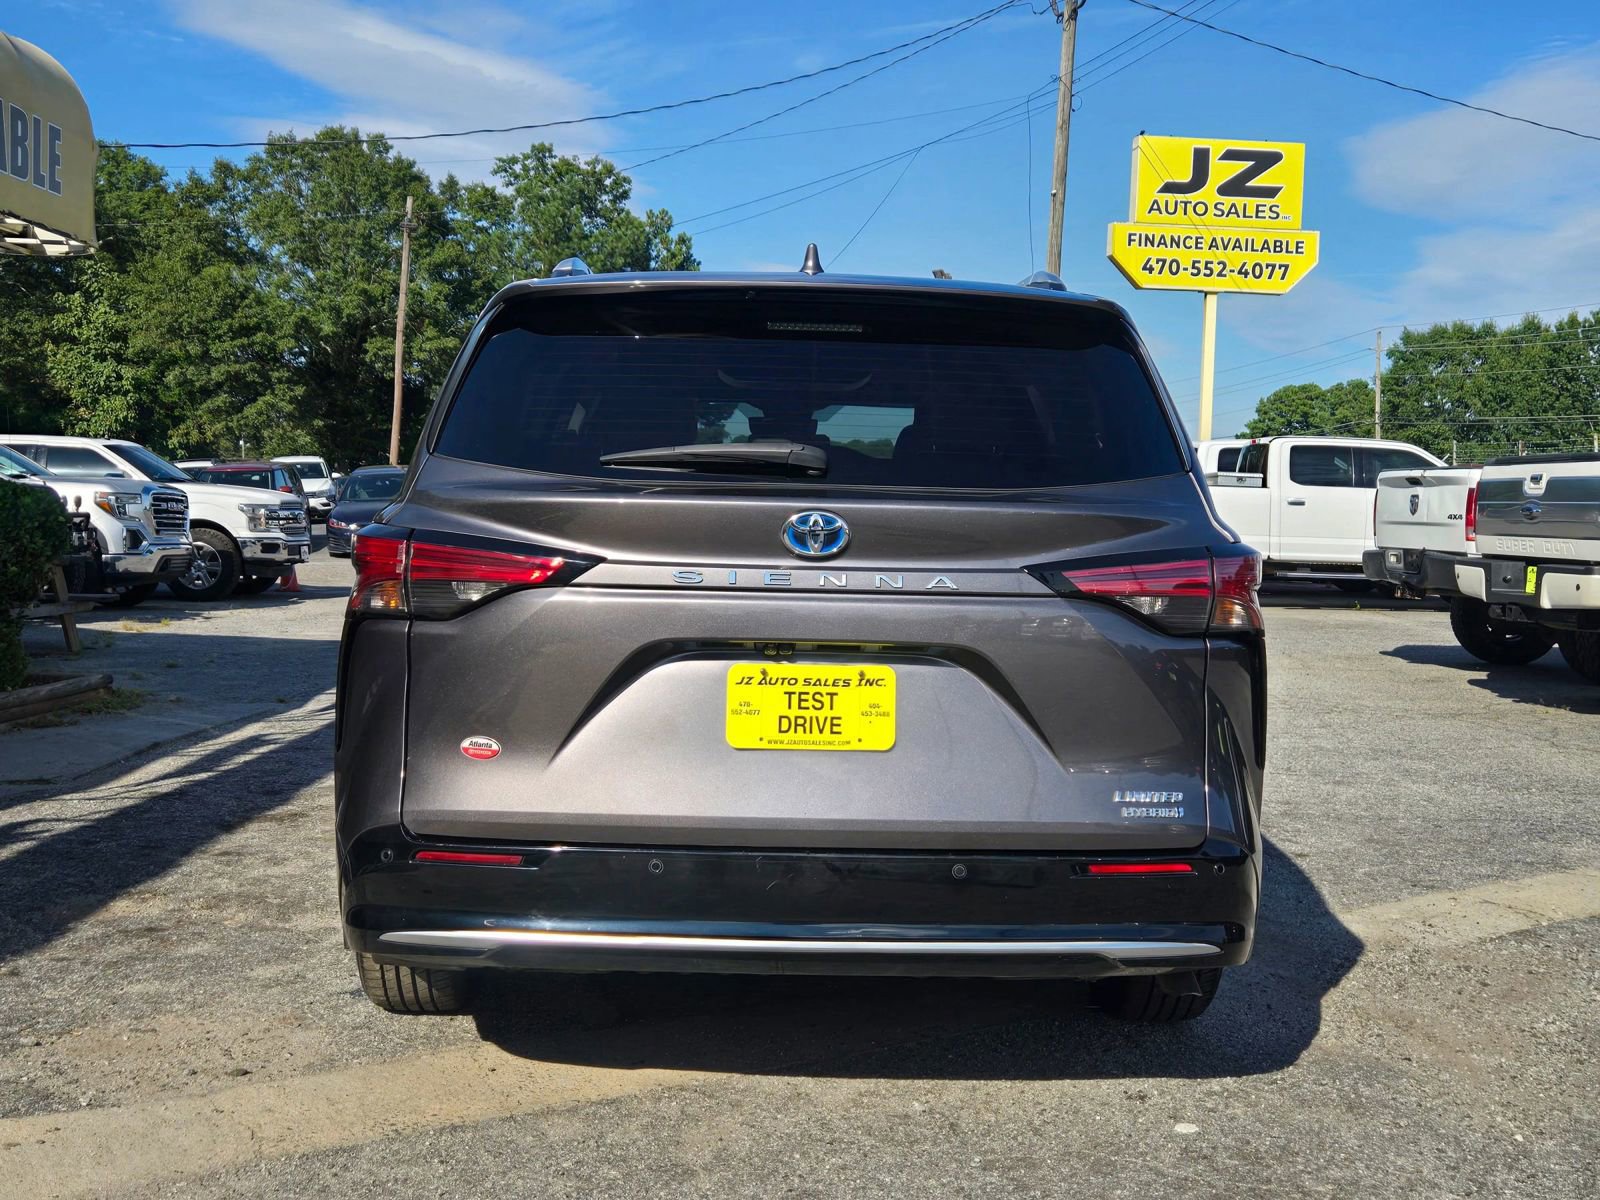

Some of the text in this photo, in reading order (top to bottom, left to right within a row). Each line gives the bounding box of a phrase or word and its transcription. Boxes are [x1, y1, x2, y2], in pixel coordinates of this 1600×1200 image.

[1156, 146, 1284, 199] JZ
[1147, 199, 1209, 217] AUTO
[1213, 202, 1281, 220] SALES
[1127, 232, 1305, 255] FINANCE AVAILABLE
[1141, 257, 1290, 281] 470-552-4077
[1496, 538, 1576, 556] SUPER DUTY
[672, 569, 959, 590] SIENNA
[735, 676, 755, 685] JZ
[757, 675, 799, 687] AUTO
[802, 677, 852, 688] SALES
[783, 691, 839, 711] TEST
[777, 715, 843, 735] DRIVE
[468, 740, 492, 748] Atlanta
